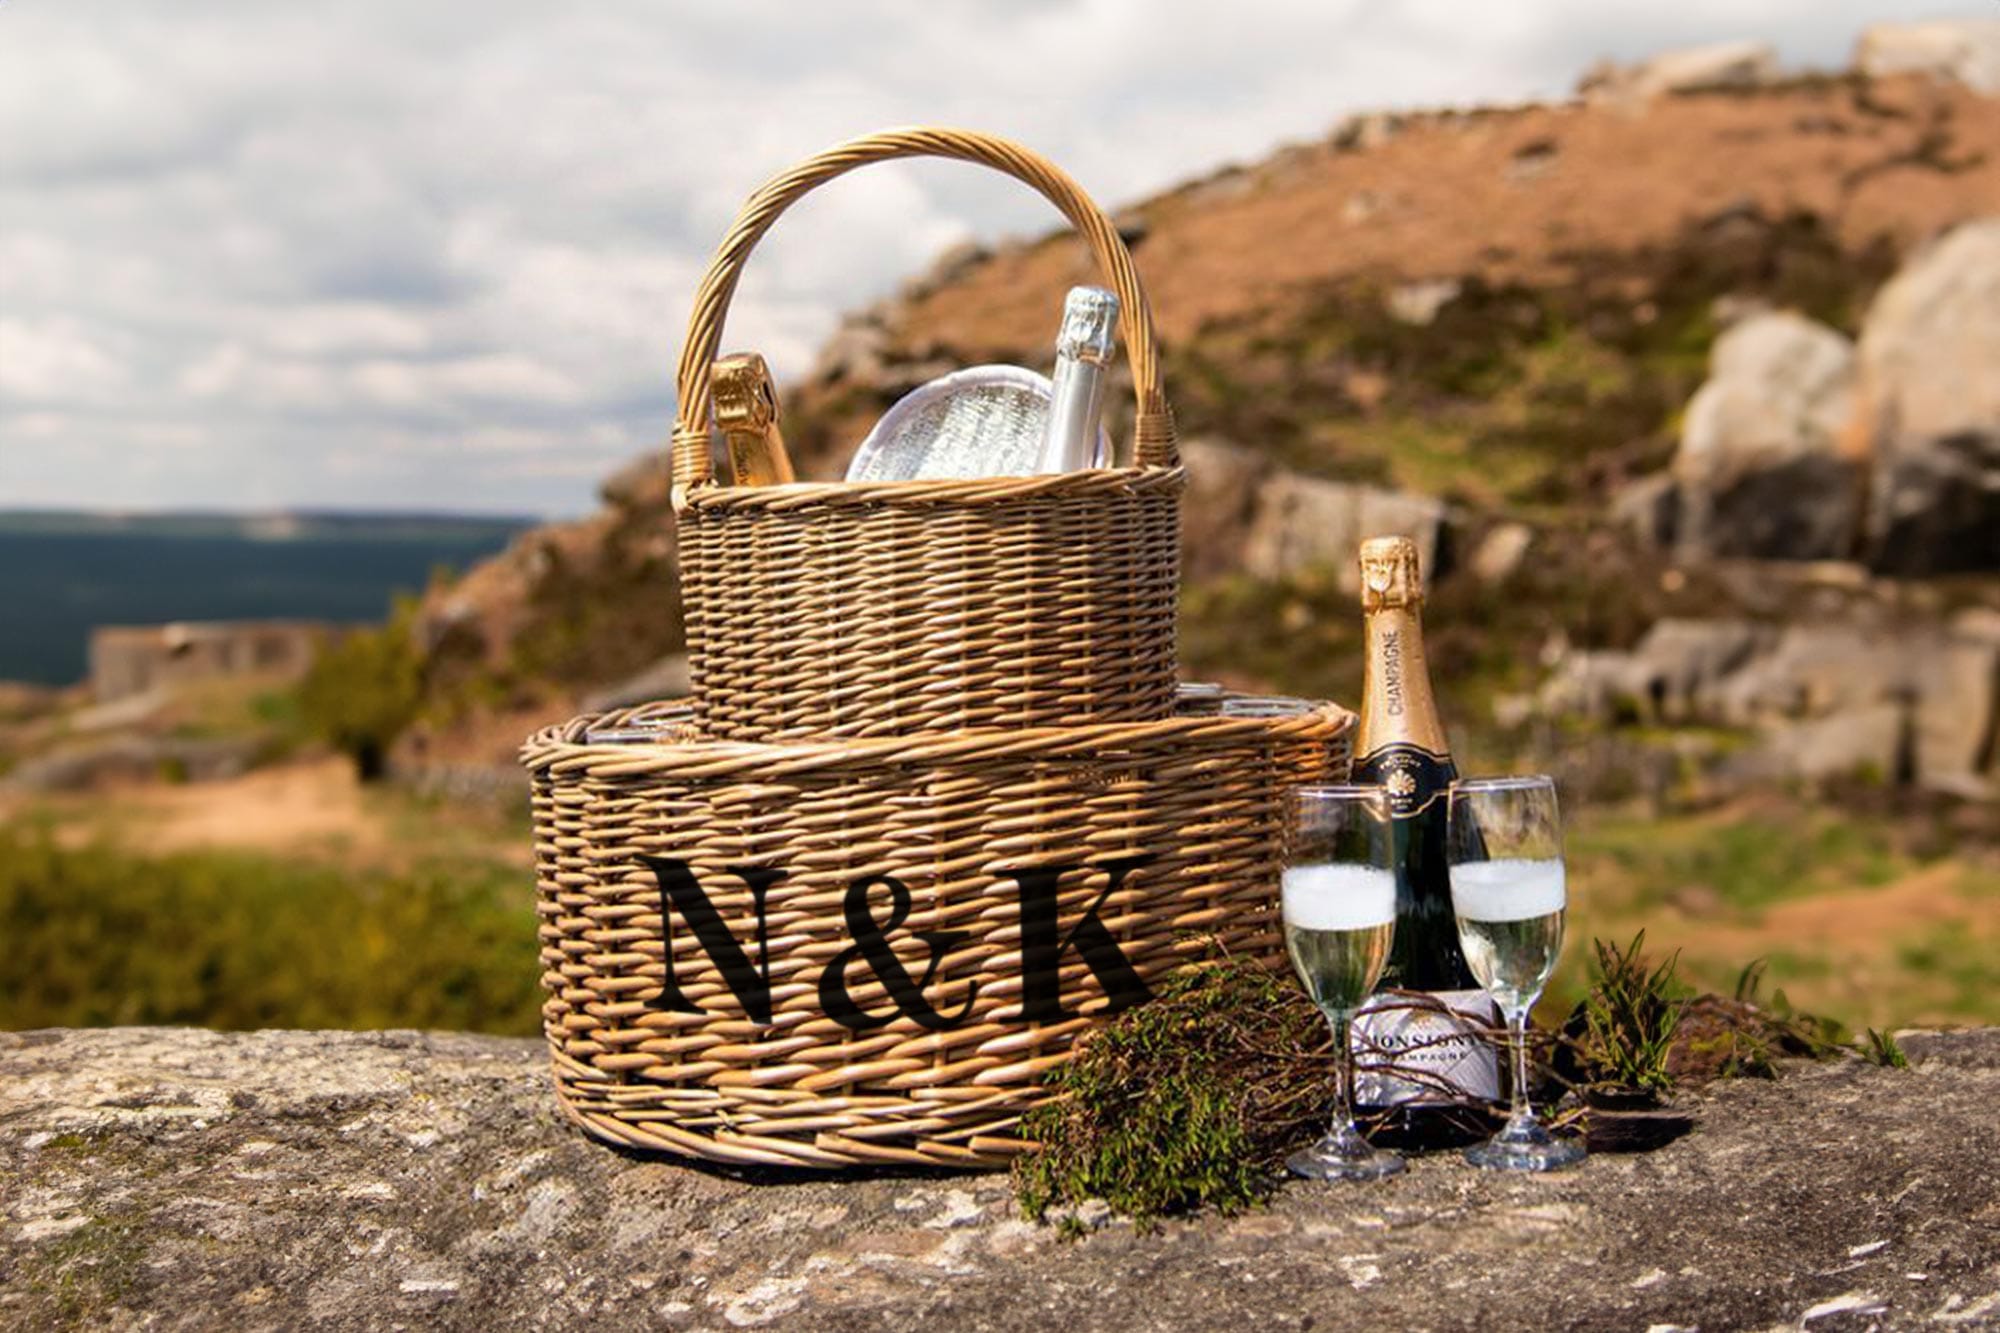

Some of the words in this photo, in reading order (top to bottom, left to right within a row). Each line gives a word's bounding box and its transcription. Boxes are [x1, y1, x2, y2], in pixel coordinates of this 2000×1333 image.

[1382, 631, 1403, 716] CHAMPAGNE
[634, 853, 788, 1025] N
[818, 875, 977, 1029] &
[994, 853, 1158, 1023] K
